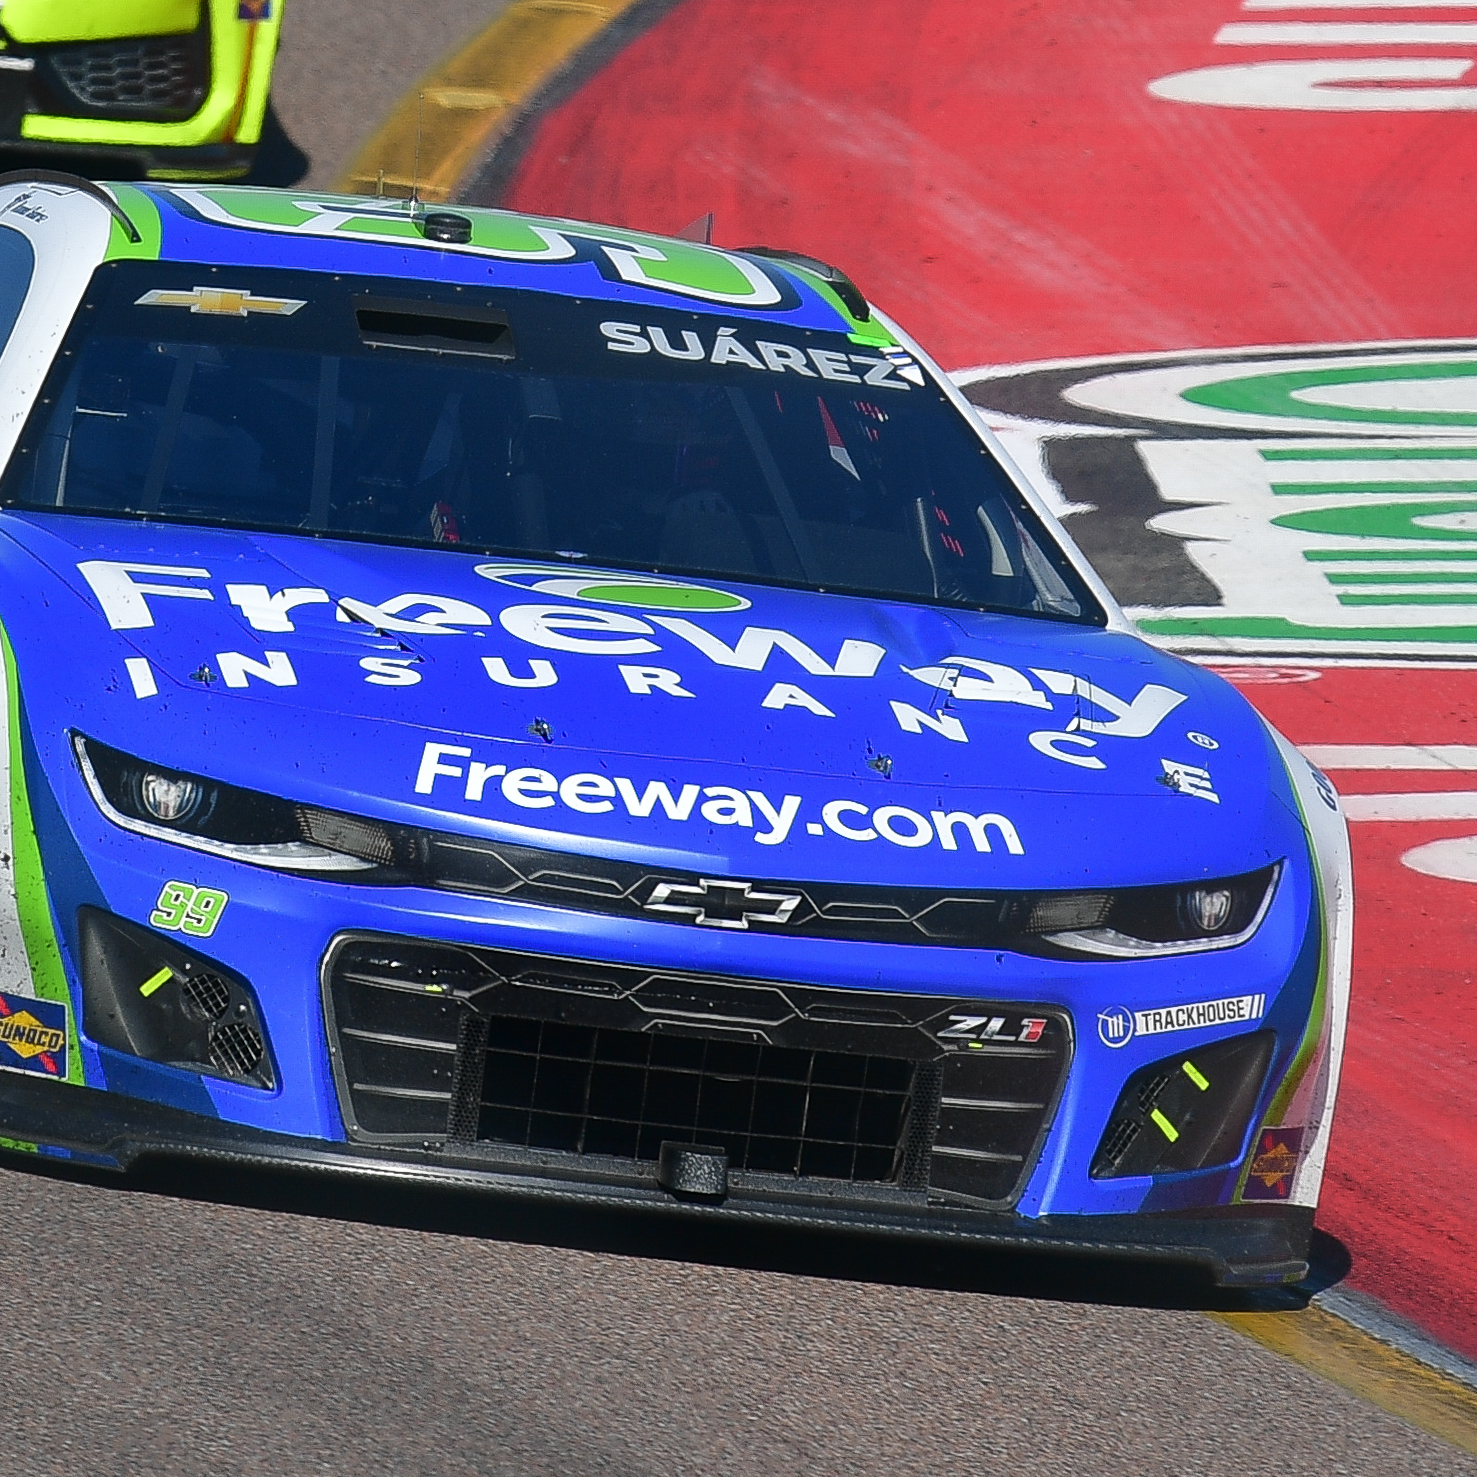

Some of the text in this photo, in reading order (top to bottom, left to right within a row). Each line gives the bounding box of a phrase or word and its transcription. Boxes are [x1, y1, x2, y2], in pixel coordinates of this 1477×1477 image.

[599, 322, 911, 391] SUÁREZ
[77, 560, 1189, 738] Freeway
[124, 651, 1221, 804] INSURANCE
[415, 742, 1025, 855] Freeway.com
[149, 879, 230, 938] 99
[936, 1014, 1048, 1042] ZL1
[1140, 999, 1246, 1035] TRACKHOUSE
